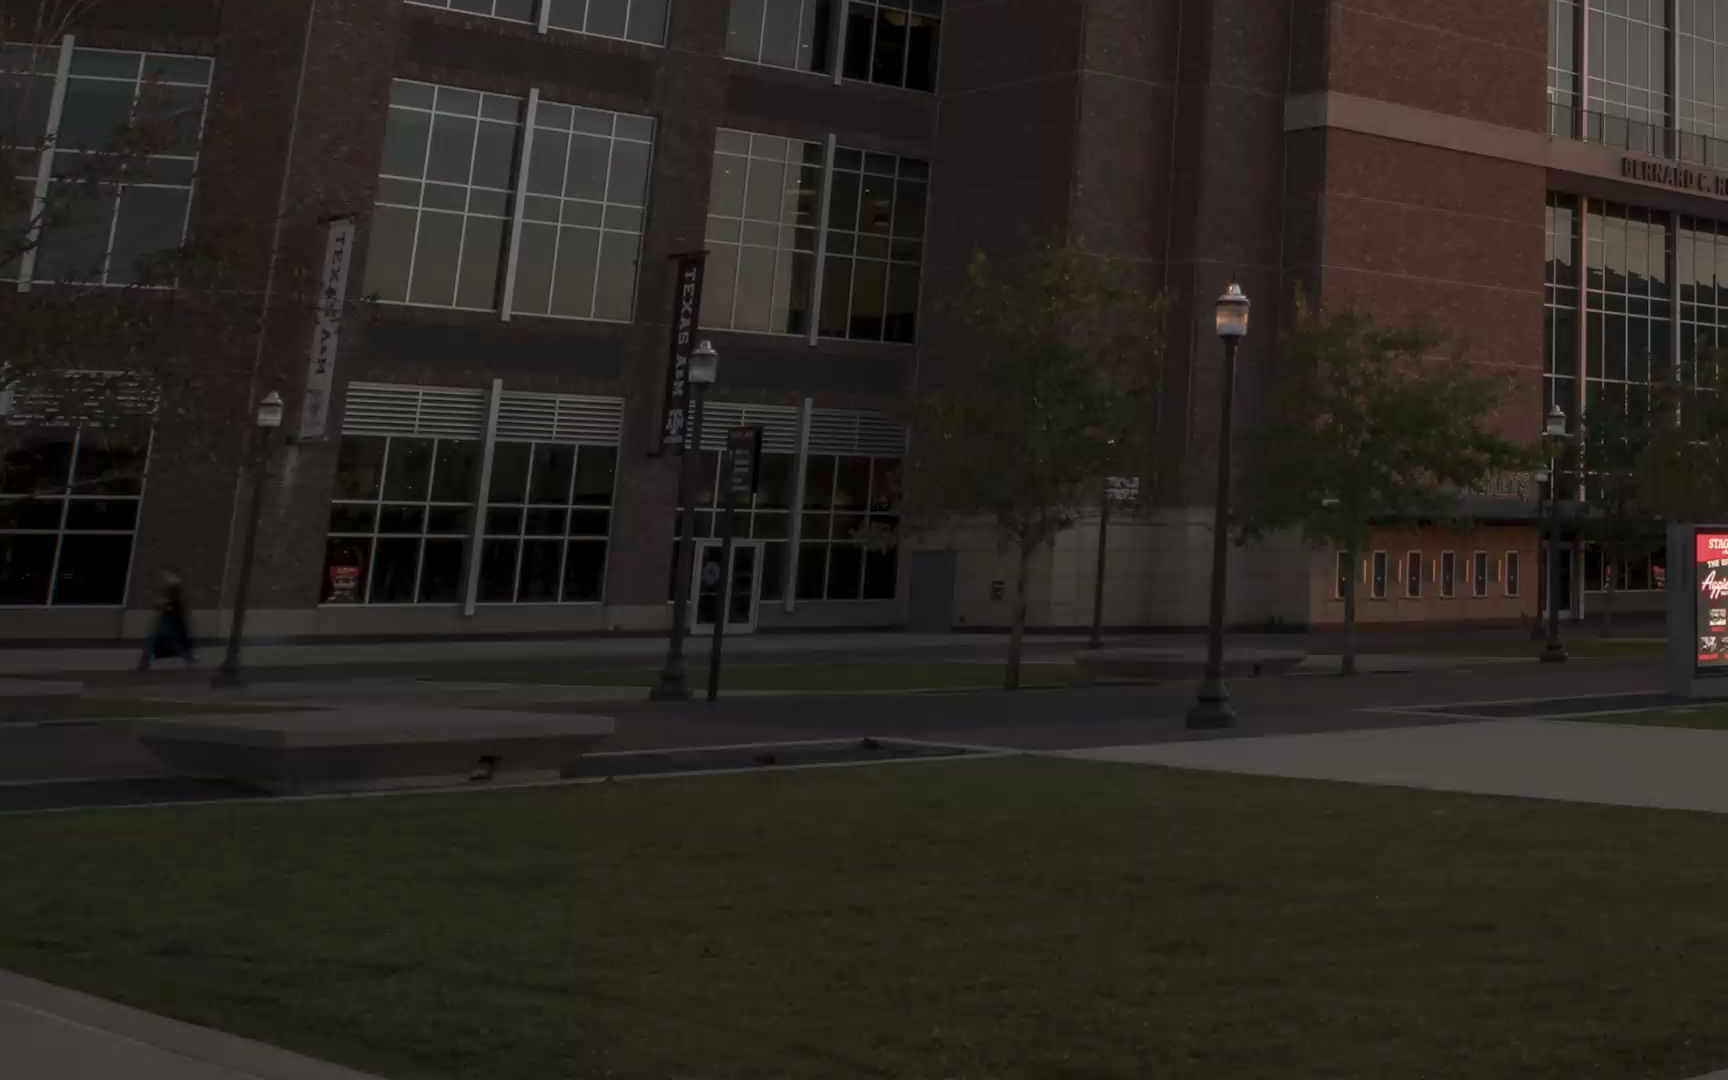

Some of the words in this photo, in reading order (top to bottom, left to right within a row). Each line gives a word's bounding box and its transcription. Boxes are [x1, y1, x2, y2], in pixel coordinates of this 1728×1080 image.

[1622, 157, 1693, 189] BERNARD
[677, 267, 697, 345] TEXAS
[1707, 559, 1719, 568] THE
